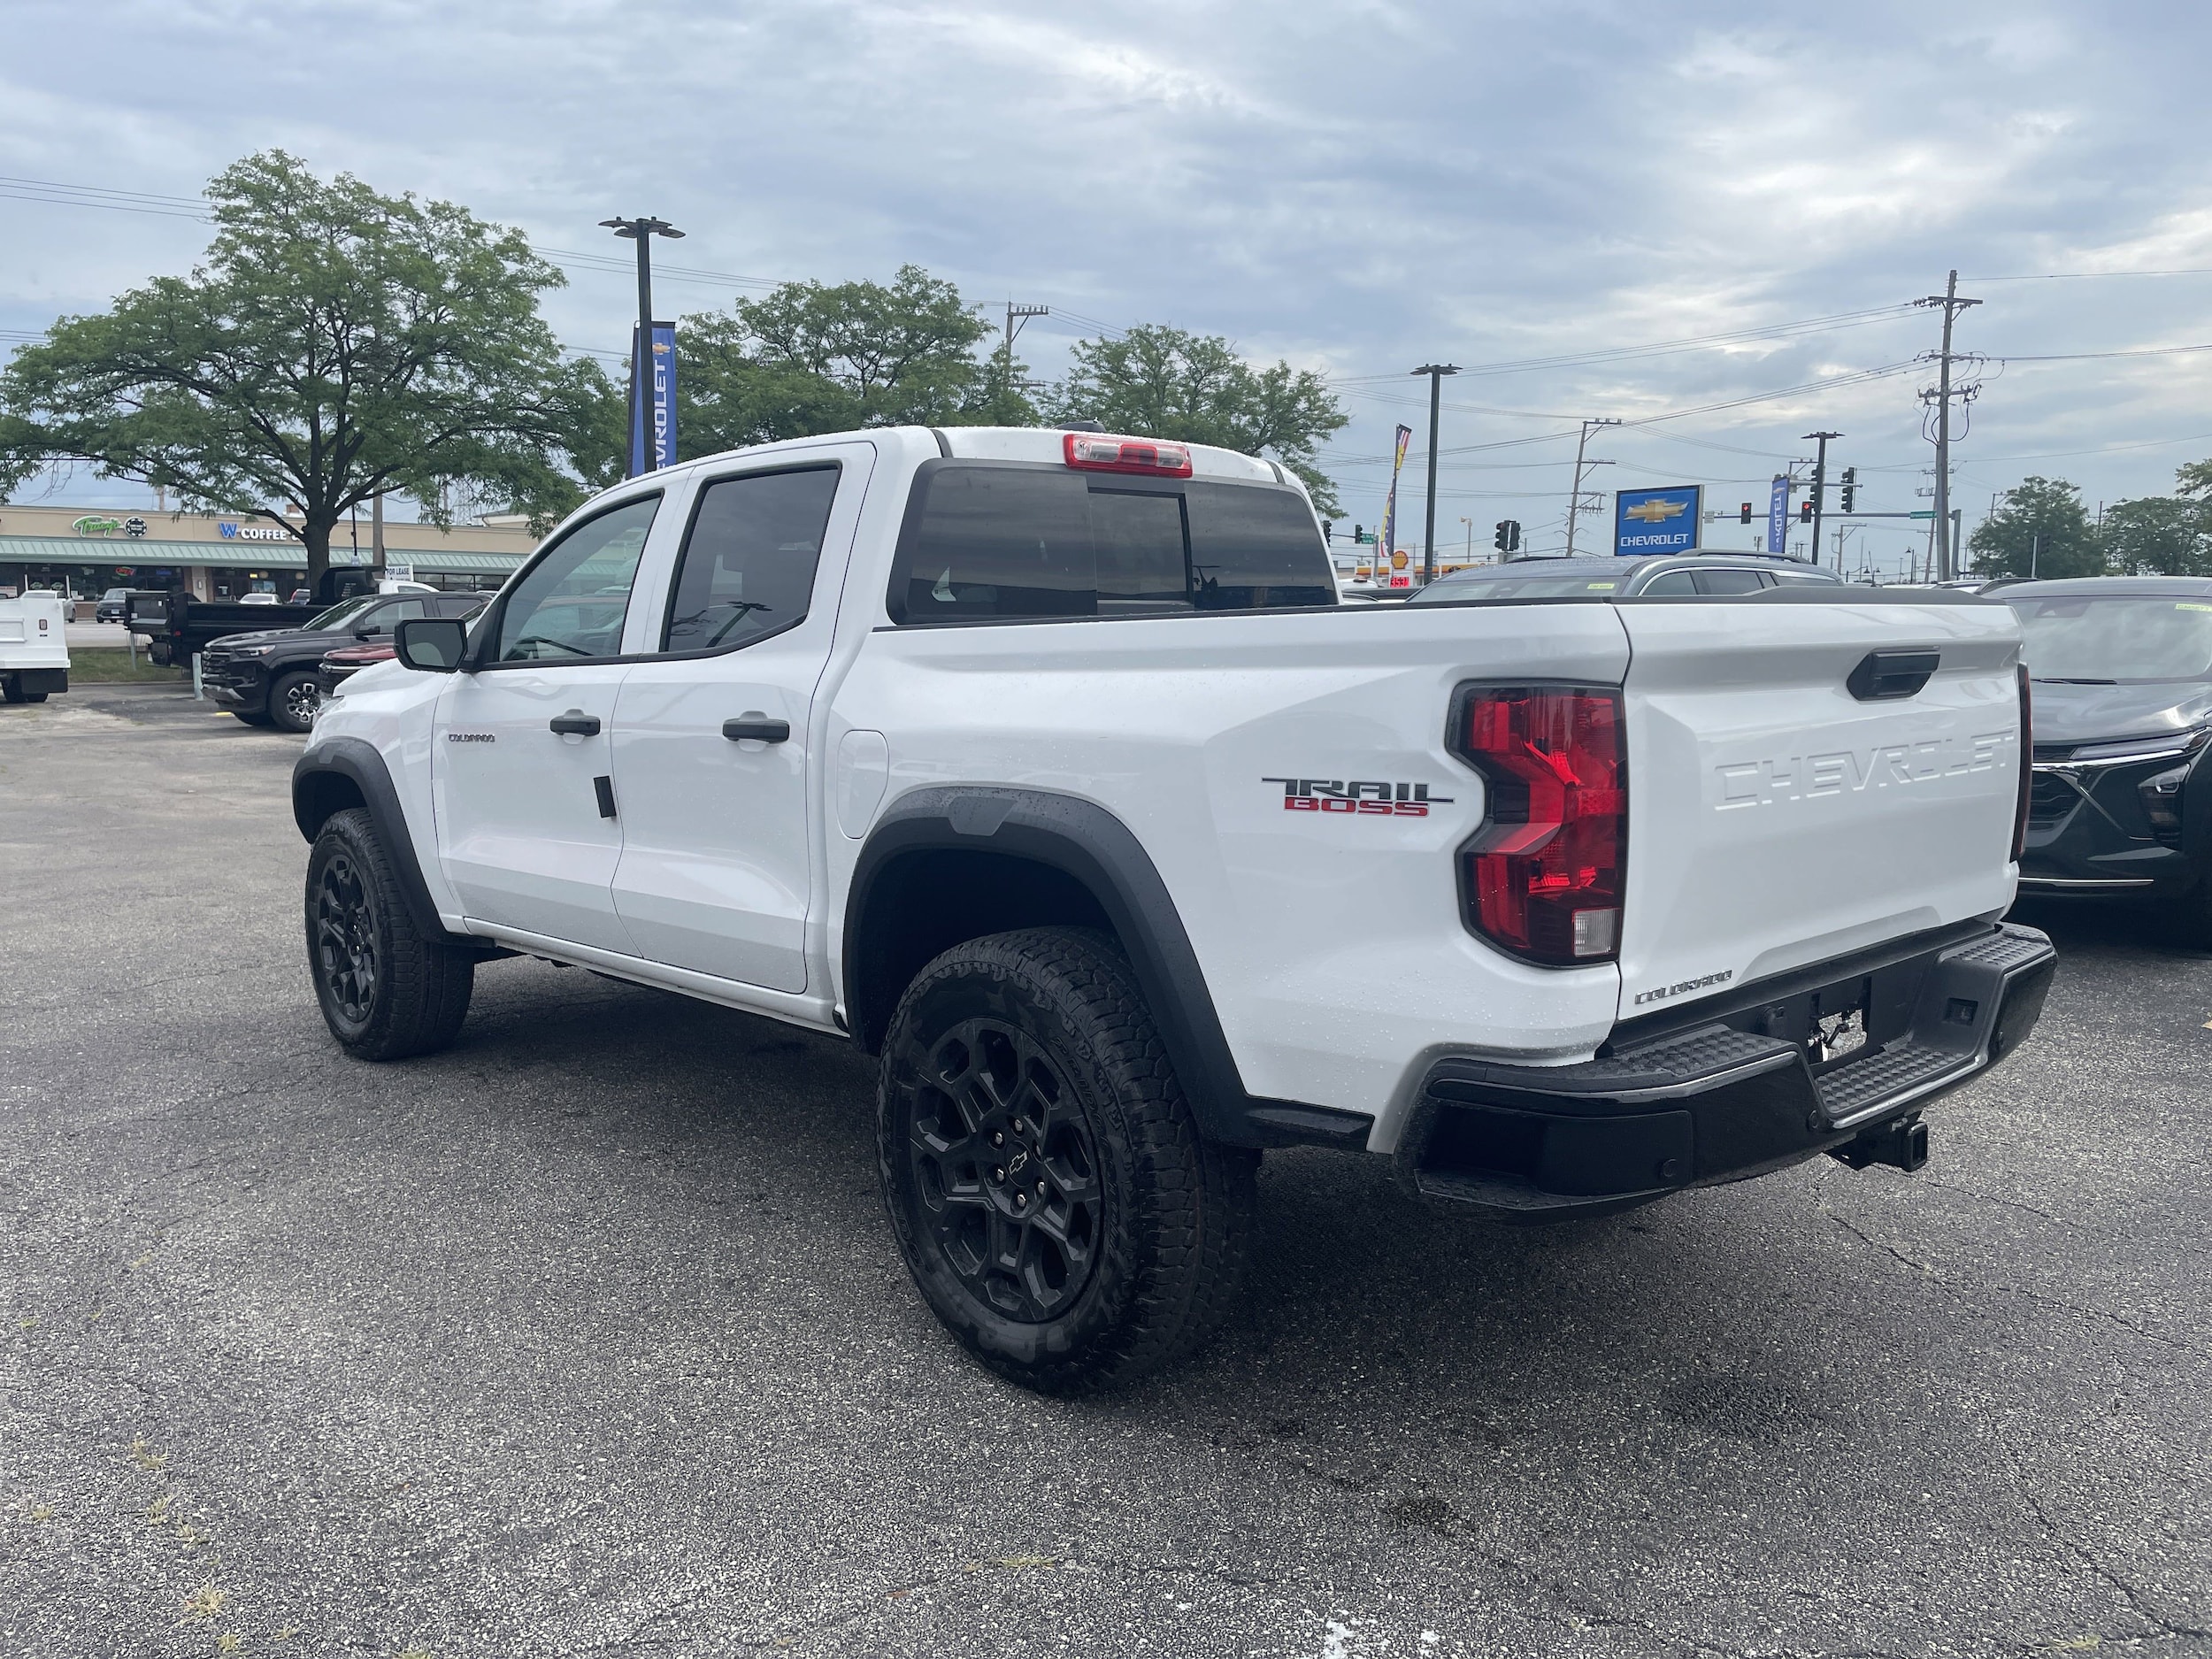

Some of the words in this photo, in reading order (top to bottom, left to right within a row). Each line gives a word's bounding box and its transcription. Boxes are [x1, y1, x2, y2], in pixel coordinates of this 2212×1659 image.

[219, 522, 238, 538] W
[241, 528, 287, 541] COFFEE
[1620, 534, 1688, 547] CHEVROLET
[449, 733, 495, 742] COLORADO
[1715, 730, 2014, 810] CHEVROLET
[1262, 778, 1454, 803] TRAIL
[1285, 796, 1428, 817] BOSS
[1634, 969, 1732, 1005] COLORADO
